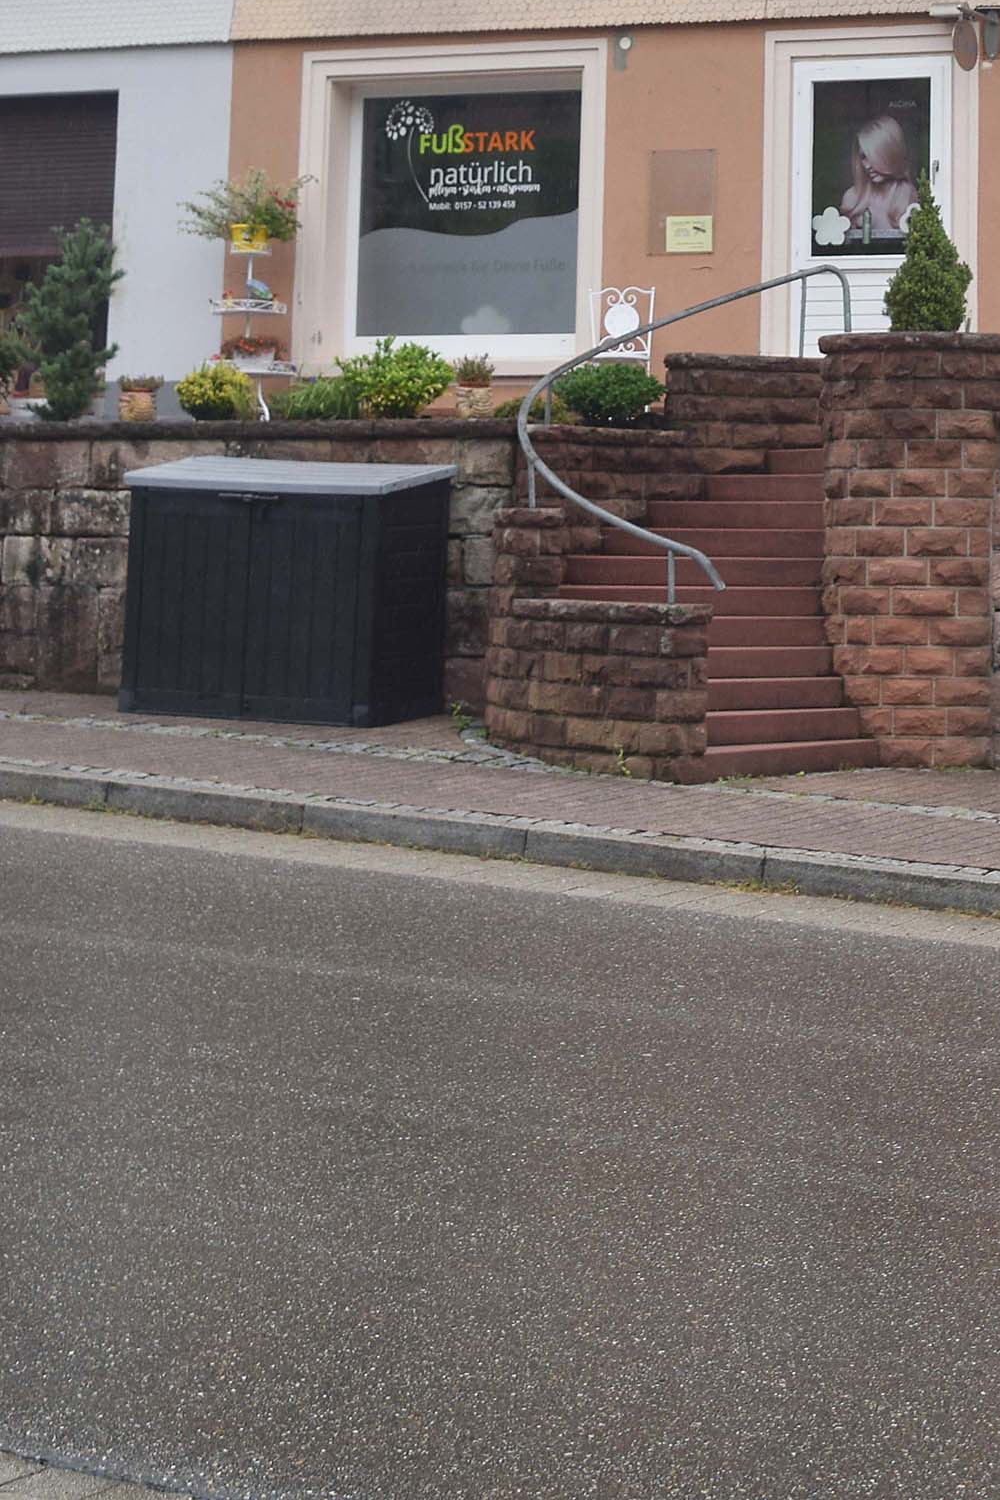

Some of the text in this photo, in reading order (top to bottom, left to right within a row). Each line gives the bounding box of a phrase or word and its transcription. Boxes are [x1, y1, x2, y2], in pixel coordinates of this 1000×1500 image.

[419, 124, 535, 154] FUßSTARK
[429, 160, 532, 185] natürlich
[428, 202, 452, 211] Mobil:
[454, 201, 472, 210] 0157
[477, 201, 487, 209] 52
